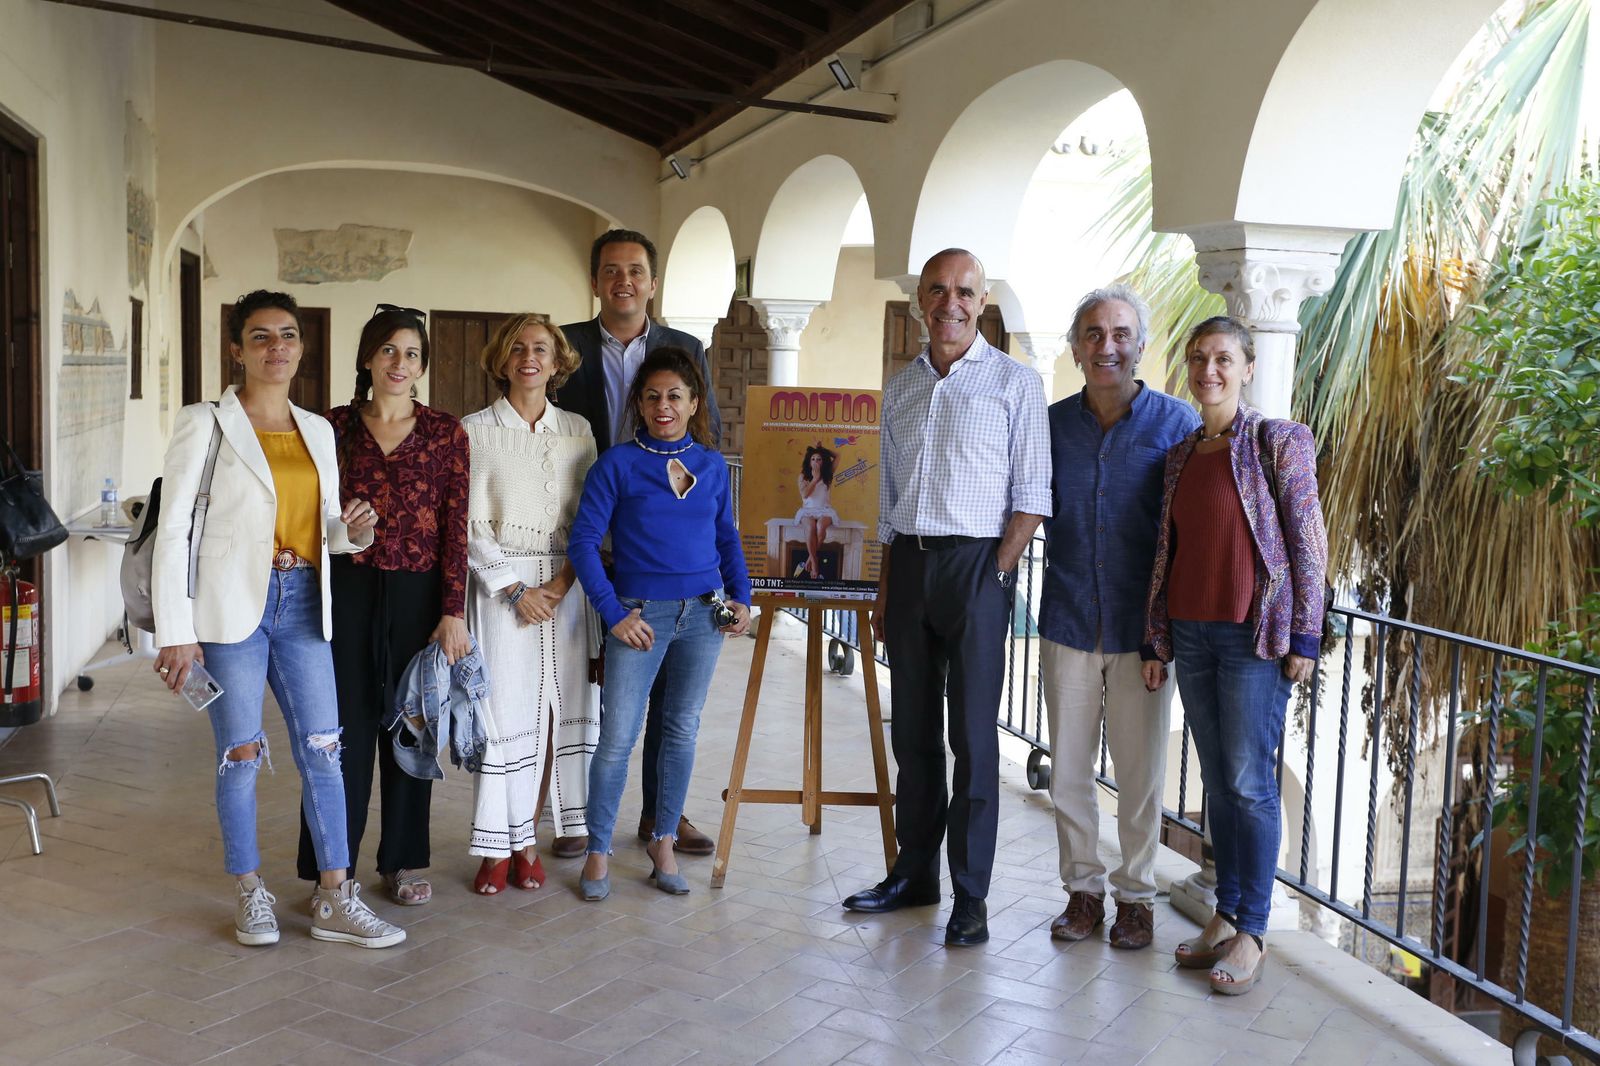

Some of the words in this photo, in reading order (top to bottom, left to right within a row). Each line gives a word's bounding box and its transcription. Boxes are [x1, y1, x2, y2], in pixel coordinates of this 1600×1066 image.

[770, 391, 877, 424] MITIN
[750, 578, 765, 587] TRO
[766, 579, 784, 588] TNT:
